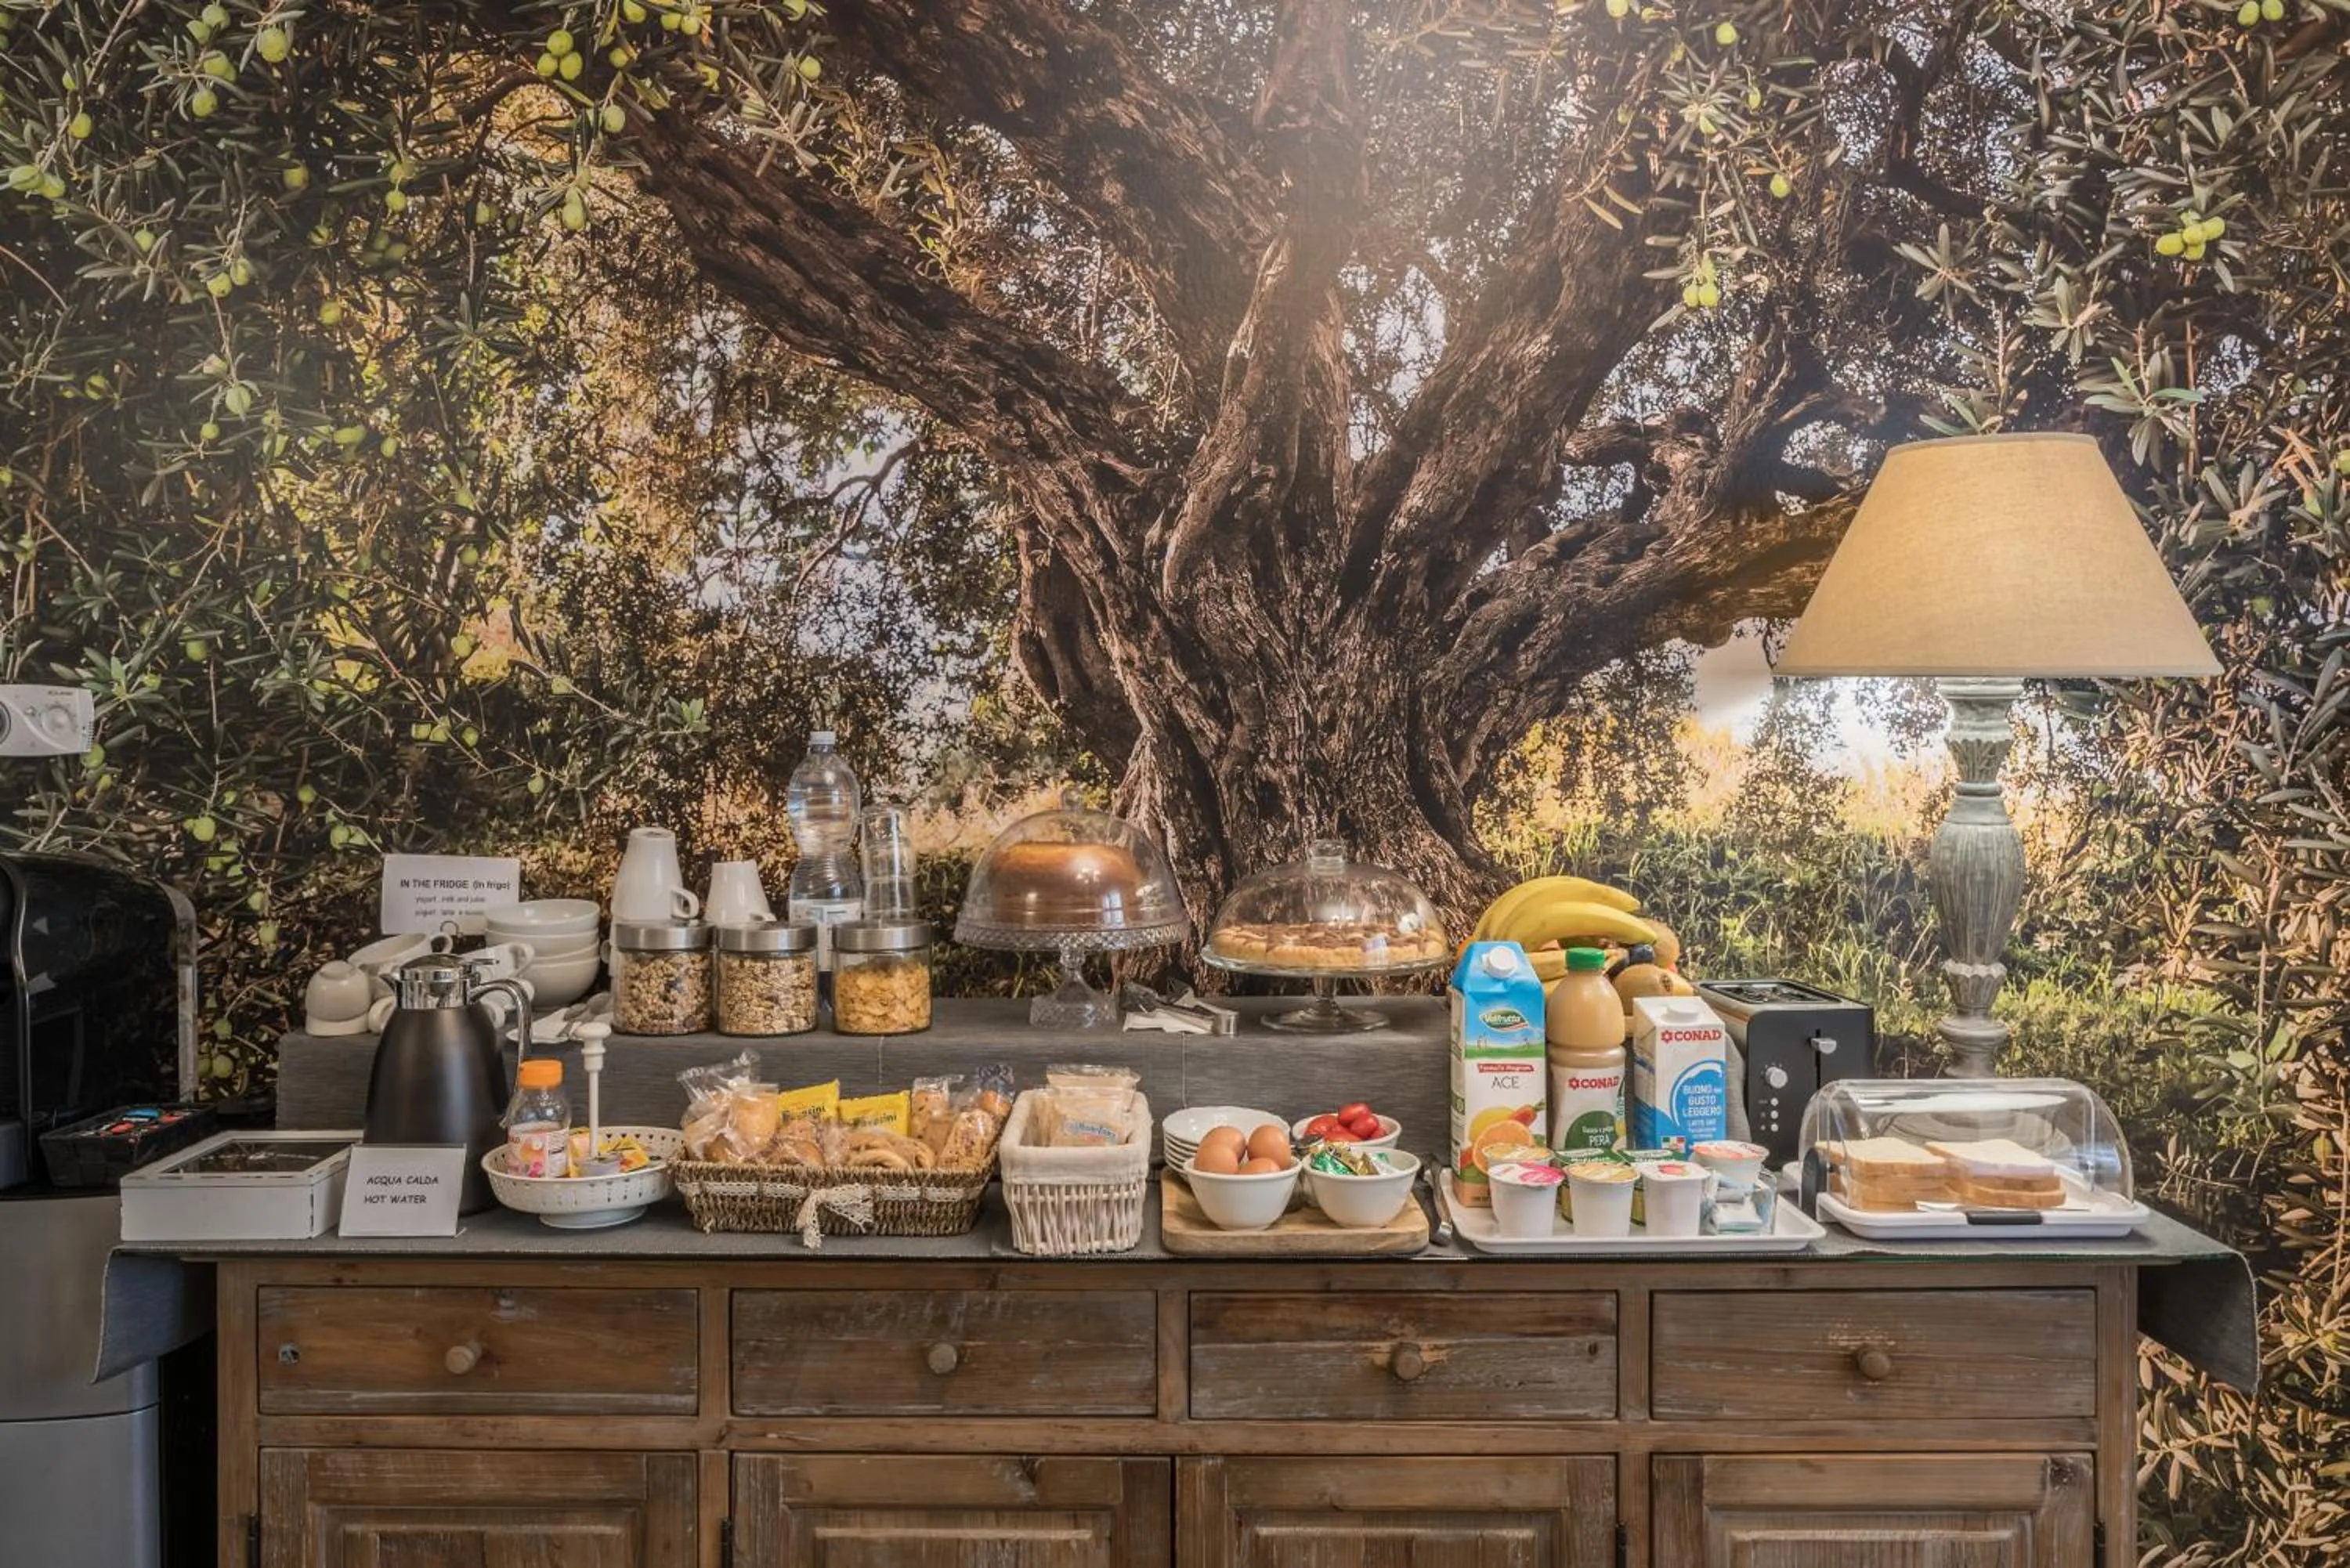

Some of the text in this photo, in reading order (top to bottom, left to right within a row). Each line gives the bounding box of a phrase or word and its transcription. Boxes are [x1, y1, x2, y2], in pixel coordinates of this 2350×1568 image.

[400, 880, 410, 889] IN
[413, 880, 431, 889] THE
[434, 880, 469, 889] FRIDGE
[1674, 1030, 1722, 1042] CONAD
[1491, 1076, 1520, 1089] ACE
[1581, 1076, 1620, 1089] CONAD
[1688, 1095, 1716, 1106] GUSTO
[1683, 1106, 1723, 1117] LEGGERO
[1589, 1133, 1611, 1147] PERA
[366, 1176, 439, 1185] ACQUA CALDA
[363, 1194, 427, 1204] HOT WATER
